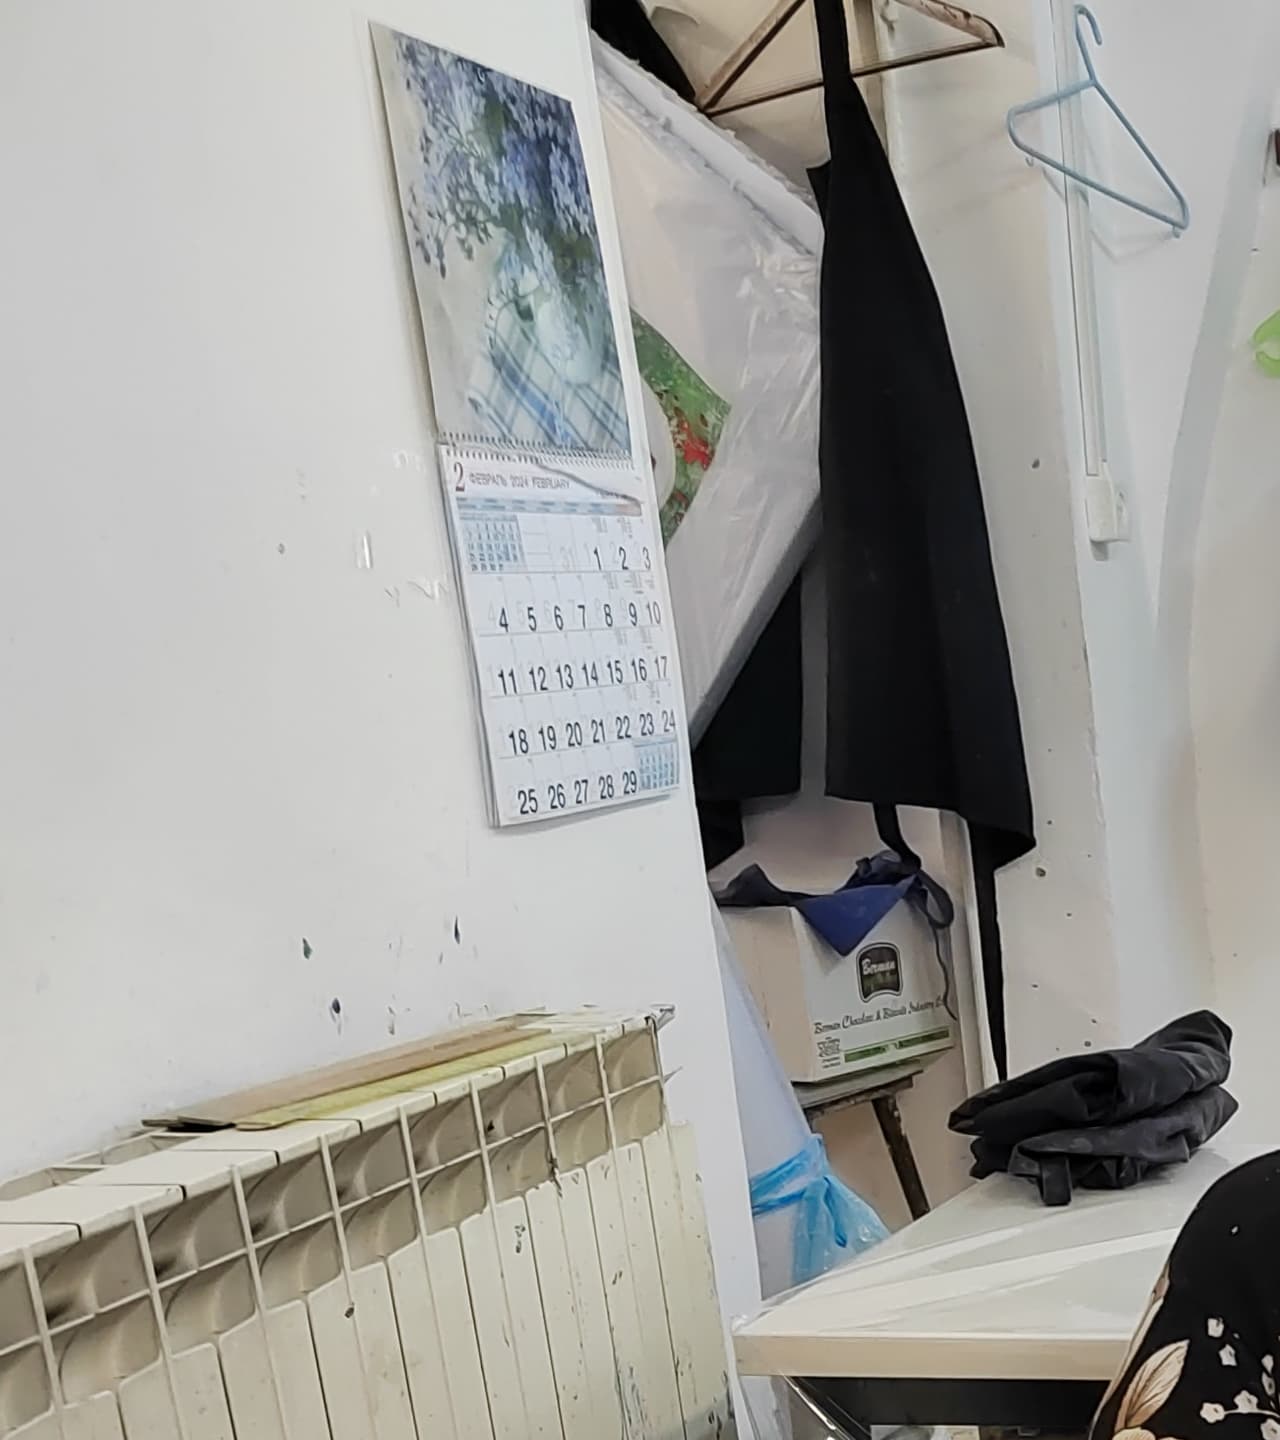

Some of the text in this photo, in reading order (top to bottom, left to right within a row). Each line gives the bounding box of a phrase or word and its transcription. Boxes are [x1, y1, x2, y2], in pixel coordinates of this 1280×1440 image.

[453, 461, 571, 492] 2 ФЕВРАЛЬ 2024 FEBRUARY
[593, 546, 652, 570] 1 2 3
[499, 601, 662, 632] 4 5 6 7 8 9 10
[498, 655, 668, 695] 11 12 13 14 15 16 17
[508, 709, 676, 755] 18 19 20 21 22 23 24
[518, 770, 638, 815] 25 26 27 28 29
